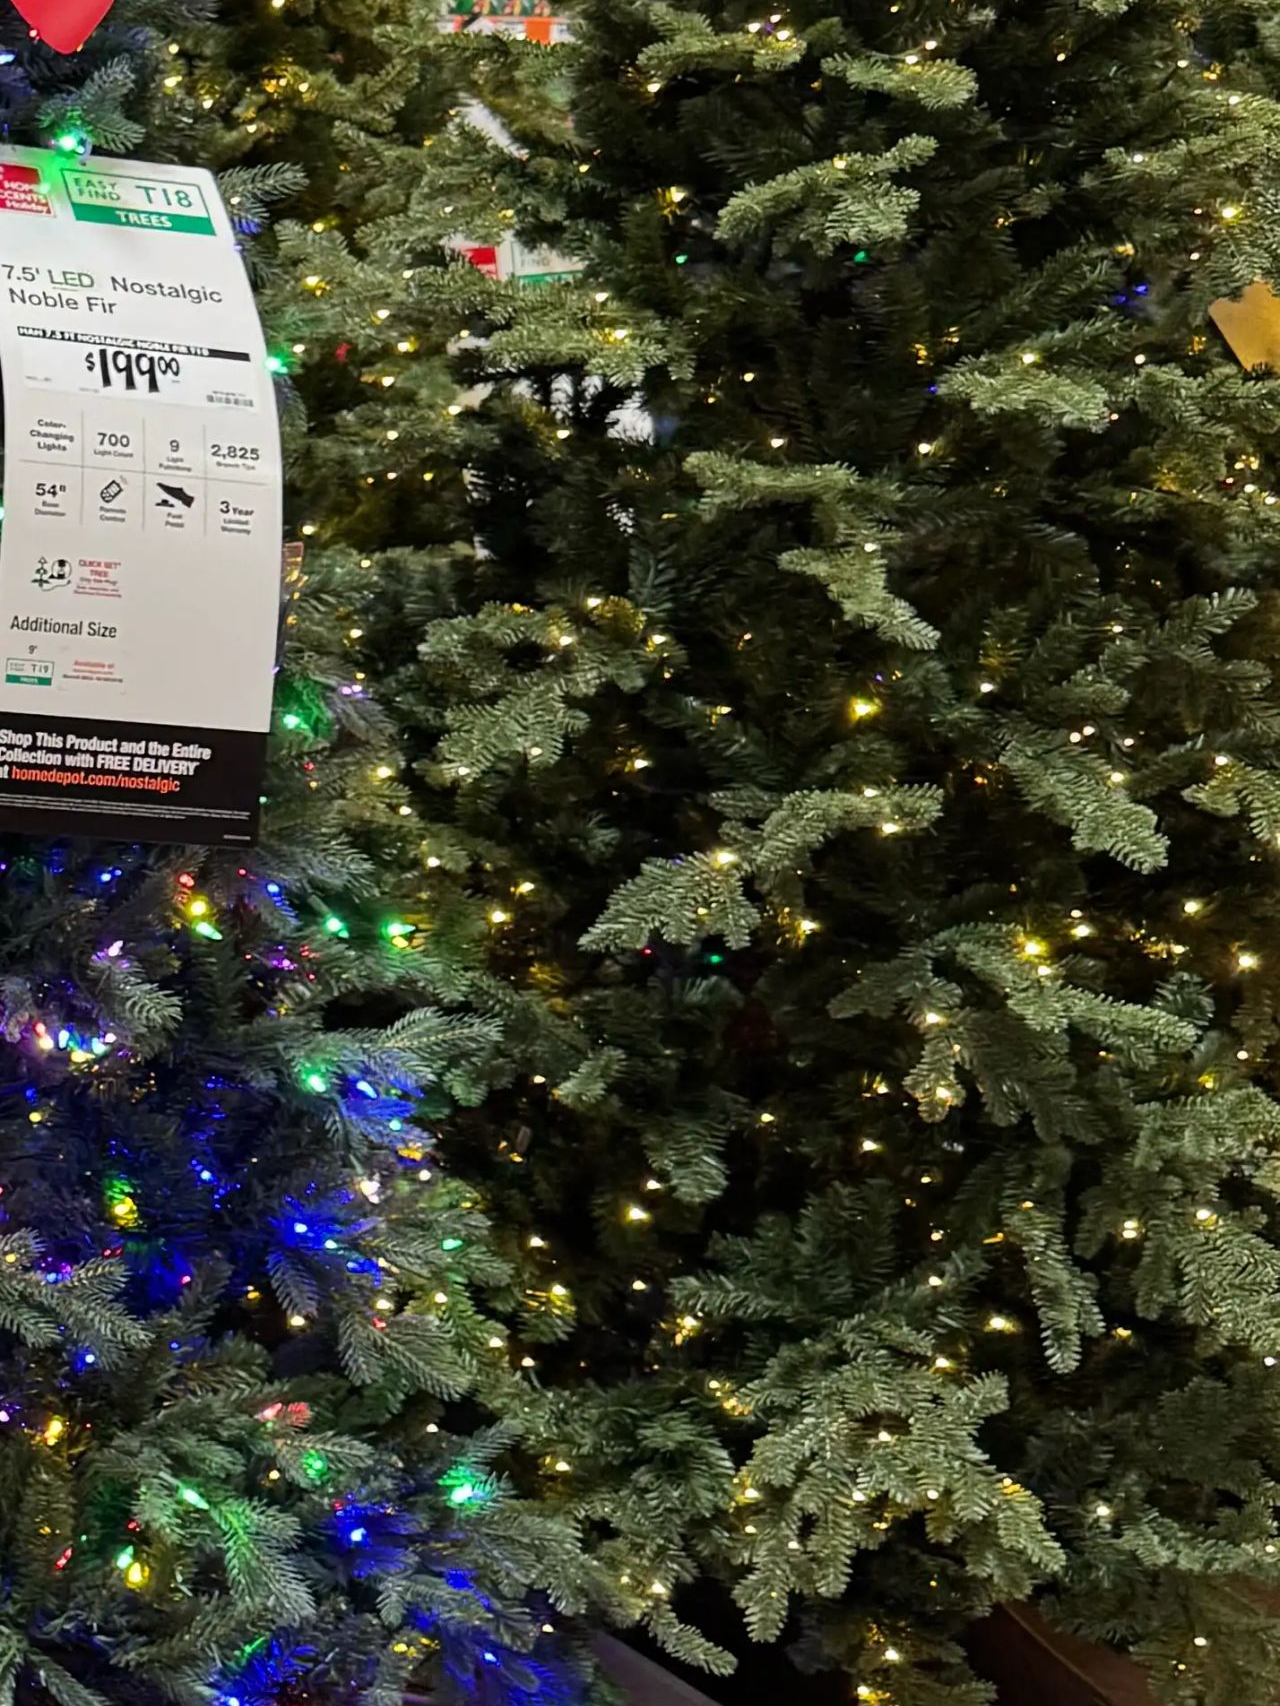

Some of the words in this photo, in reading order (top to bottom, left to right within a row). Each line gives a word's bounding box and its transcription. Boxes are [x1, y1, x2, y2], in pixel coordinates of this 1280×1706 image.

[73, 177, 118, 193] EASY
[134, 184, 194, 209] T18
[78, 187, 122, 202] FIND
[114, 210, 173, 229] TREES
[1, 264, 40, 283] 7.5'
[47, 269, 95, 289] LED
[110, 275, 223, 305] Nostalgic
[8, 287, 80, 311] Noble
[86, 295, 118, 315] Fir
[29, 429, 75, 443] Changing
[96, 431, 132, 449] 700
[210, 444, 261, 462] 2,825
[34, 482, 67, 499] 54"
[219, 500, 231, 515] 3
[231, 506, 256, 518] Year
[10, 614, 84, 637] Additional
[86, 621, 118, 639] Size
[35, 731, 64, 750] This
[66, 733, 119, 754] Product
[120, 738, 146, 756] and
[147, 740, 171, 758] the
[171, 742, 213, 761] Entire
[64, 750, 95, 769] with
[96, 754, 132, 772] FREE
[11, 765, 182, 794] homedepot.com/nostalgic
